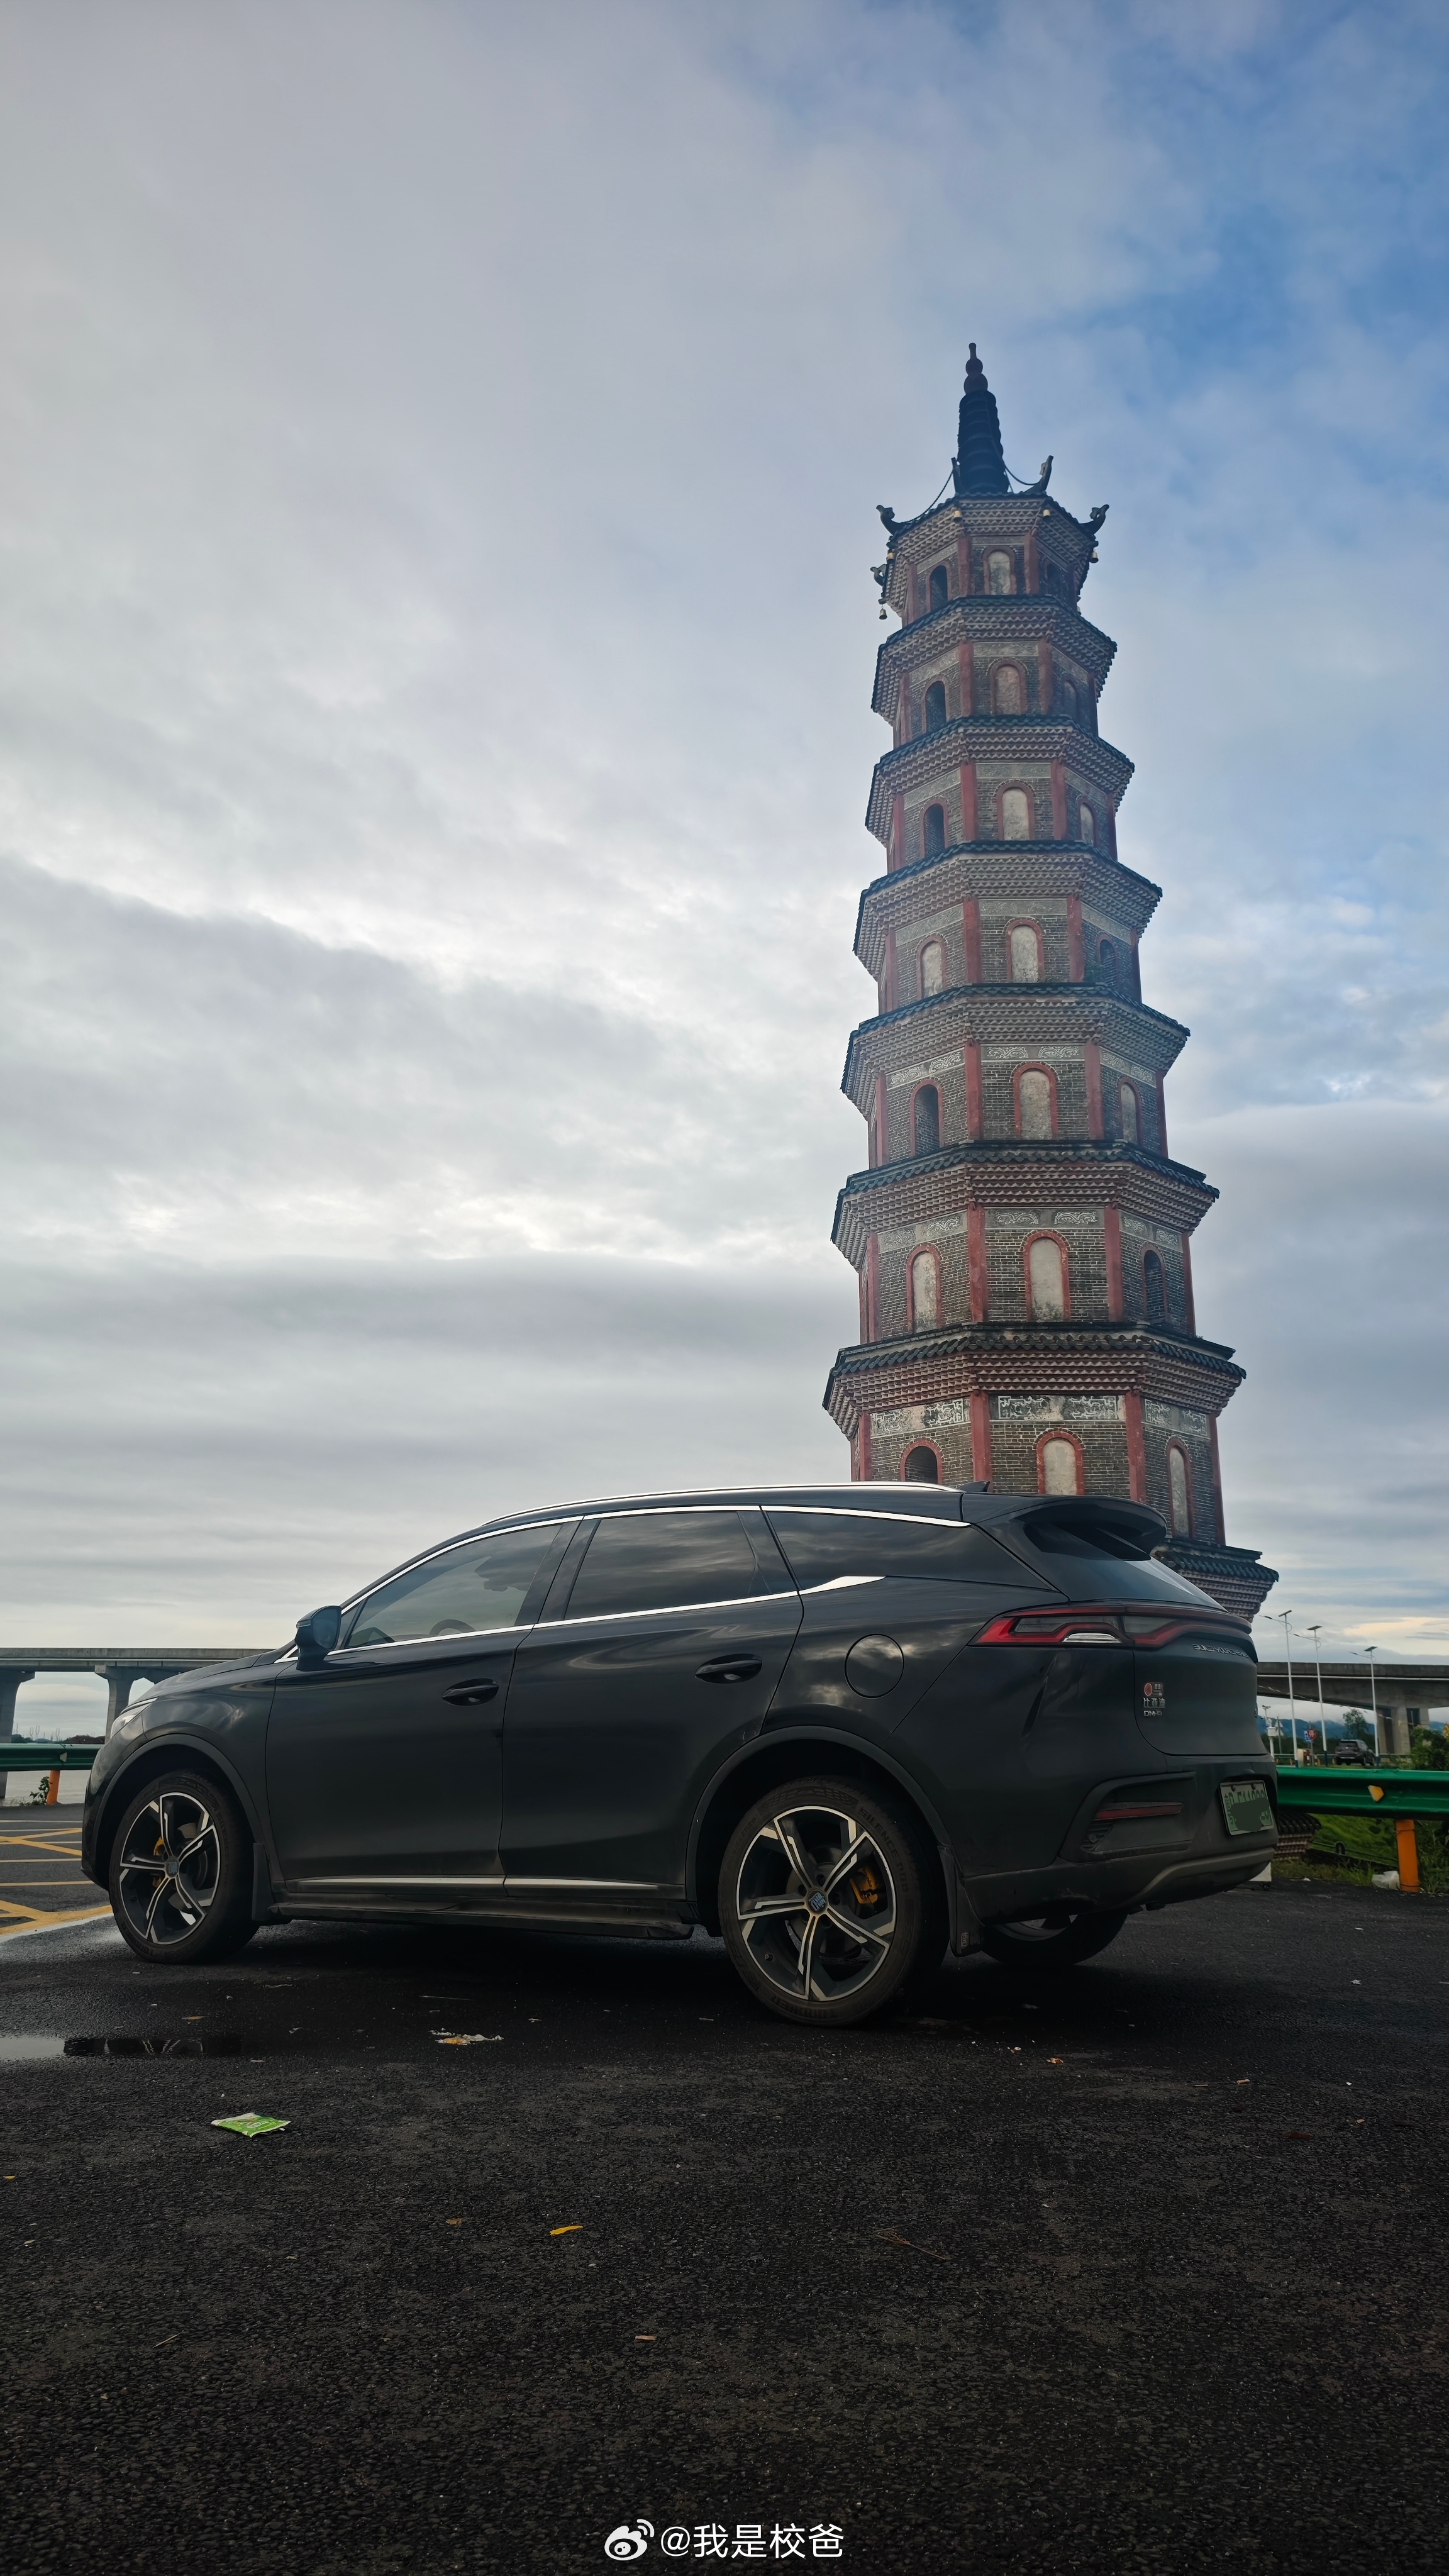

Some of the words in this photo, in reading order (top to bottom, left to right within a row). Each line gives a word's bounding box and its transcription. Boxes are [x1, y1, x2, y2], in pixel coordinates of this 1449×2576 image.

[1143, 1697, 1165, 1708] 比亚迪
[860, 1807, 899, 1857] SILENCE
